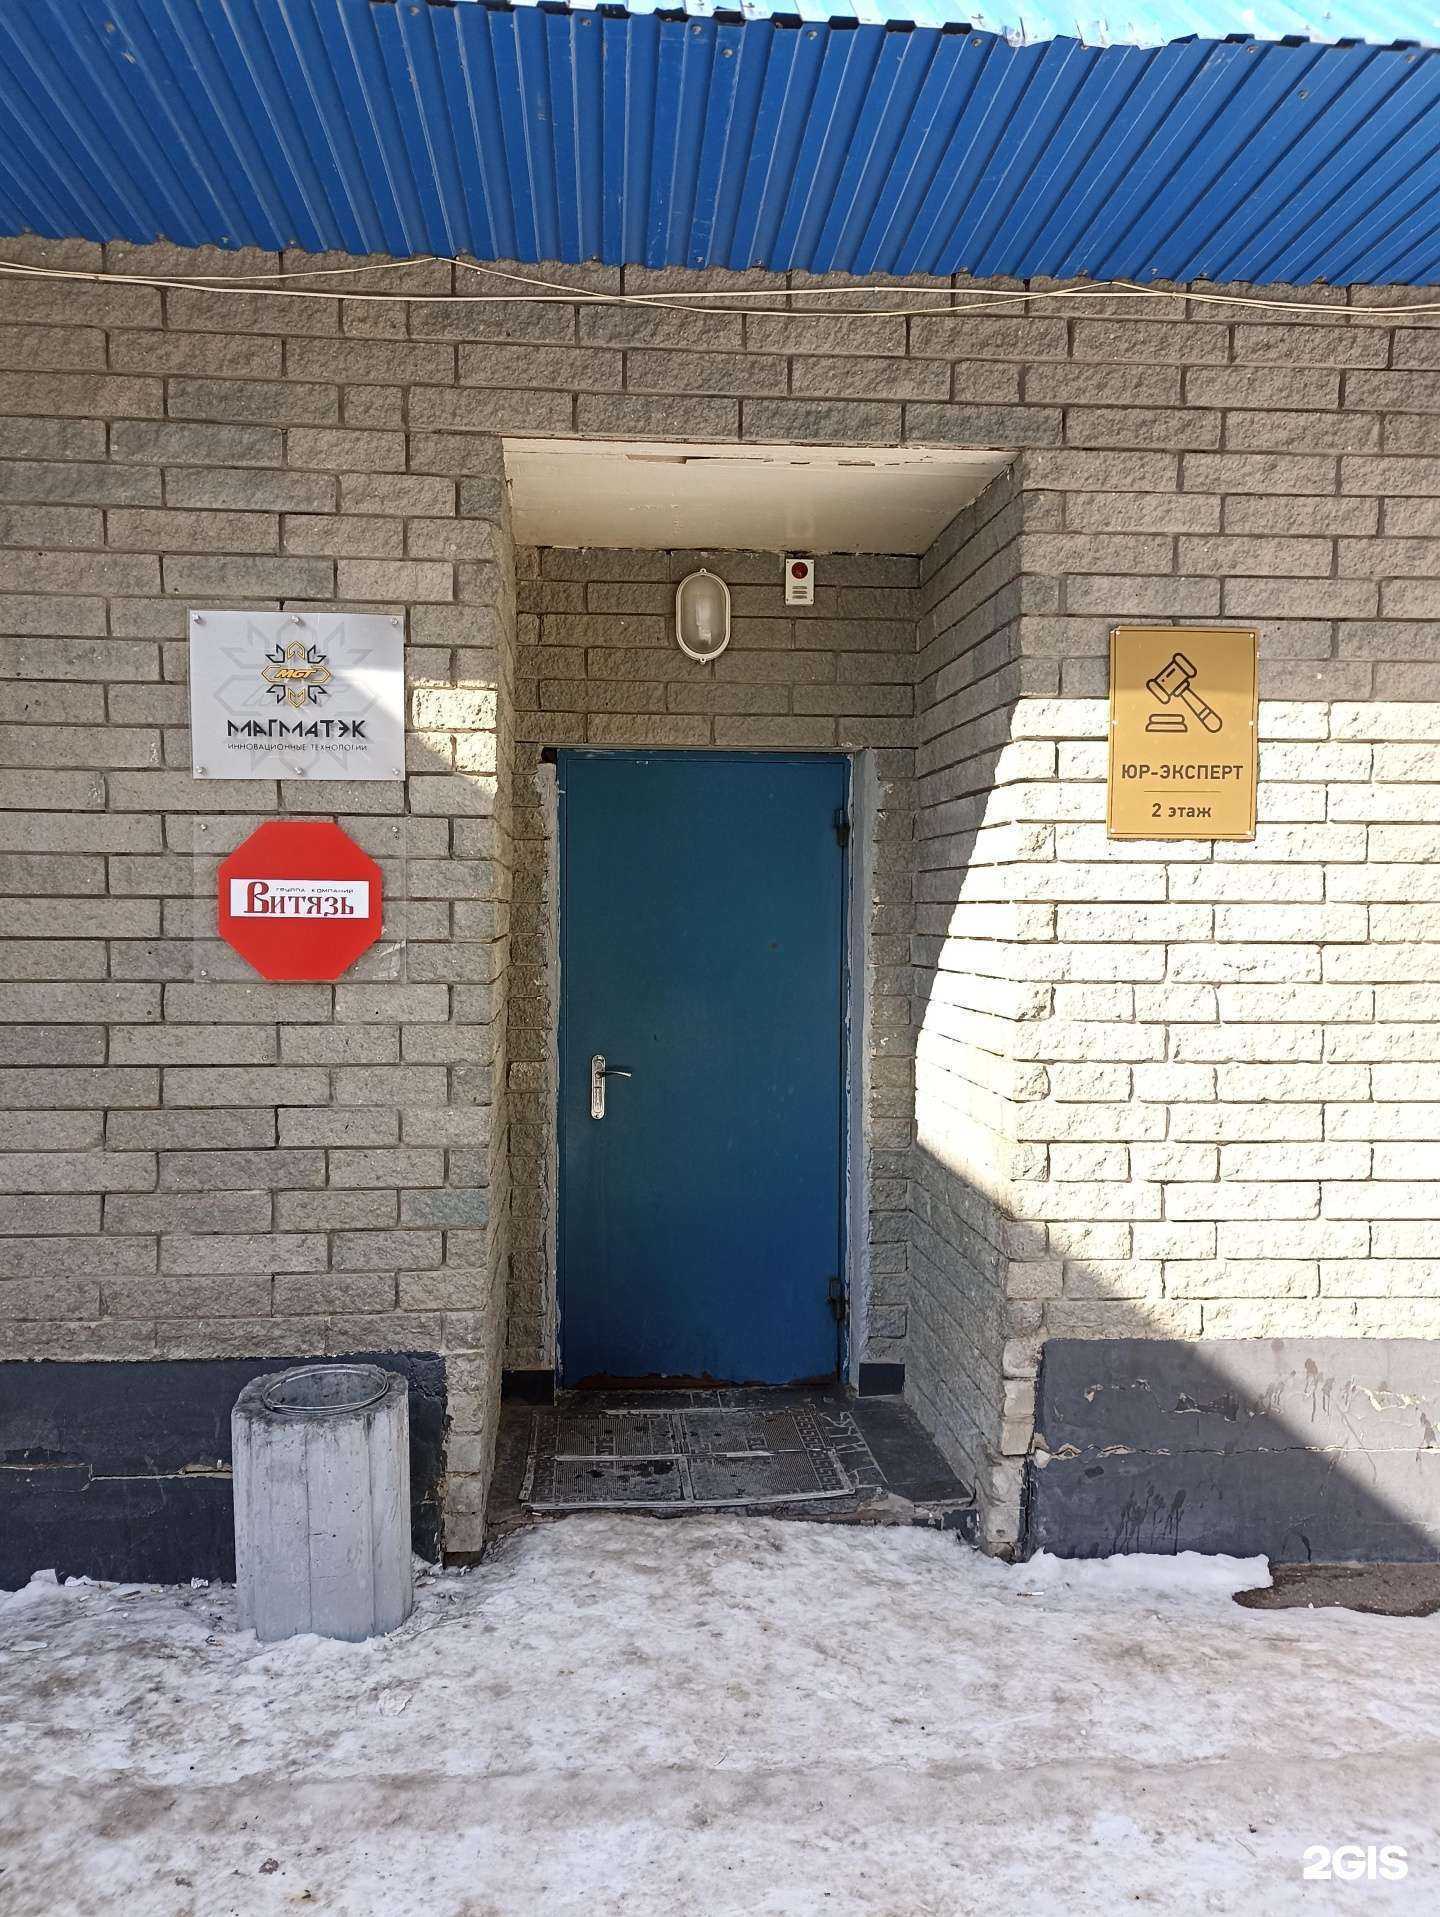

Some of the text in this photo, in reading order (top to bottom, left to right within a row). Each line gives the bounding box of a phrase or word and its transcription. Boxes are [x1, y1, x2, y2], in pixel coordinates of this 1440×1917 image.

[275, 668, 316, 679] MGT
[227, 719, 366, 738] МАГМАТЭК
[227, 743, 368, 752] ИННОВАЦИОННЫЕ ТЕХНОЛОГИИ
[1121, 764, 1244, 780] ЮР-ЭКСПЕРТ
[1151, 802, 1212, 818] 2 этаж
